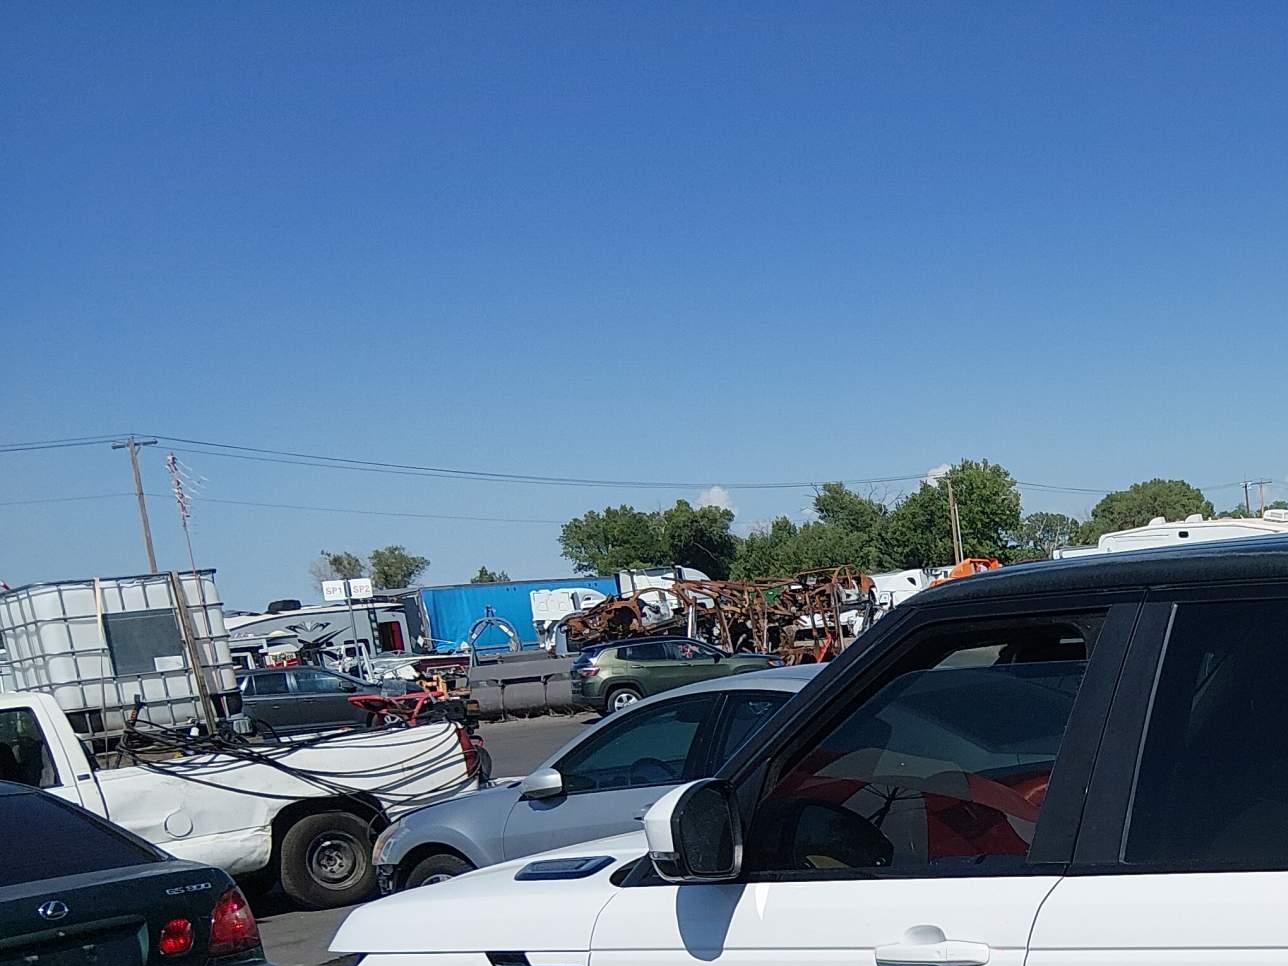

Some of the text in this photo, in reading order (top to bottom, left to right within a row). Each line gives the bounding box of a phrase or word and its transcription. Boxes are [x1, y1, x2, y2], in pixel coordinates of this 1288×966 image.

[325, 586, 343, 595] SP1
[352, 584, 371, 594] SP2
[165, 886, 186, 896] GS
